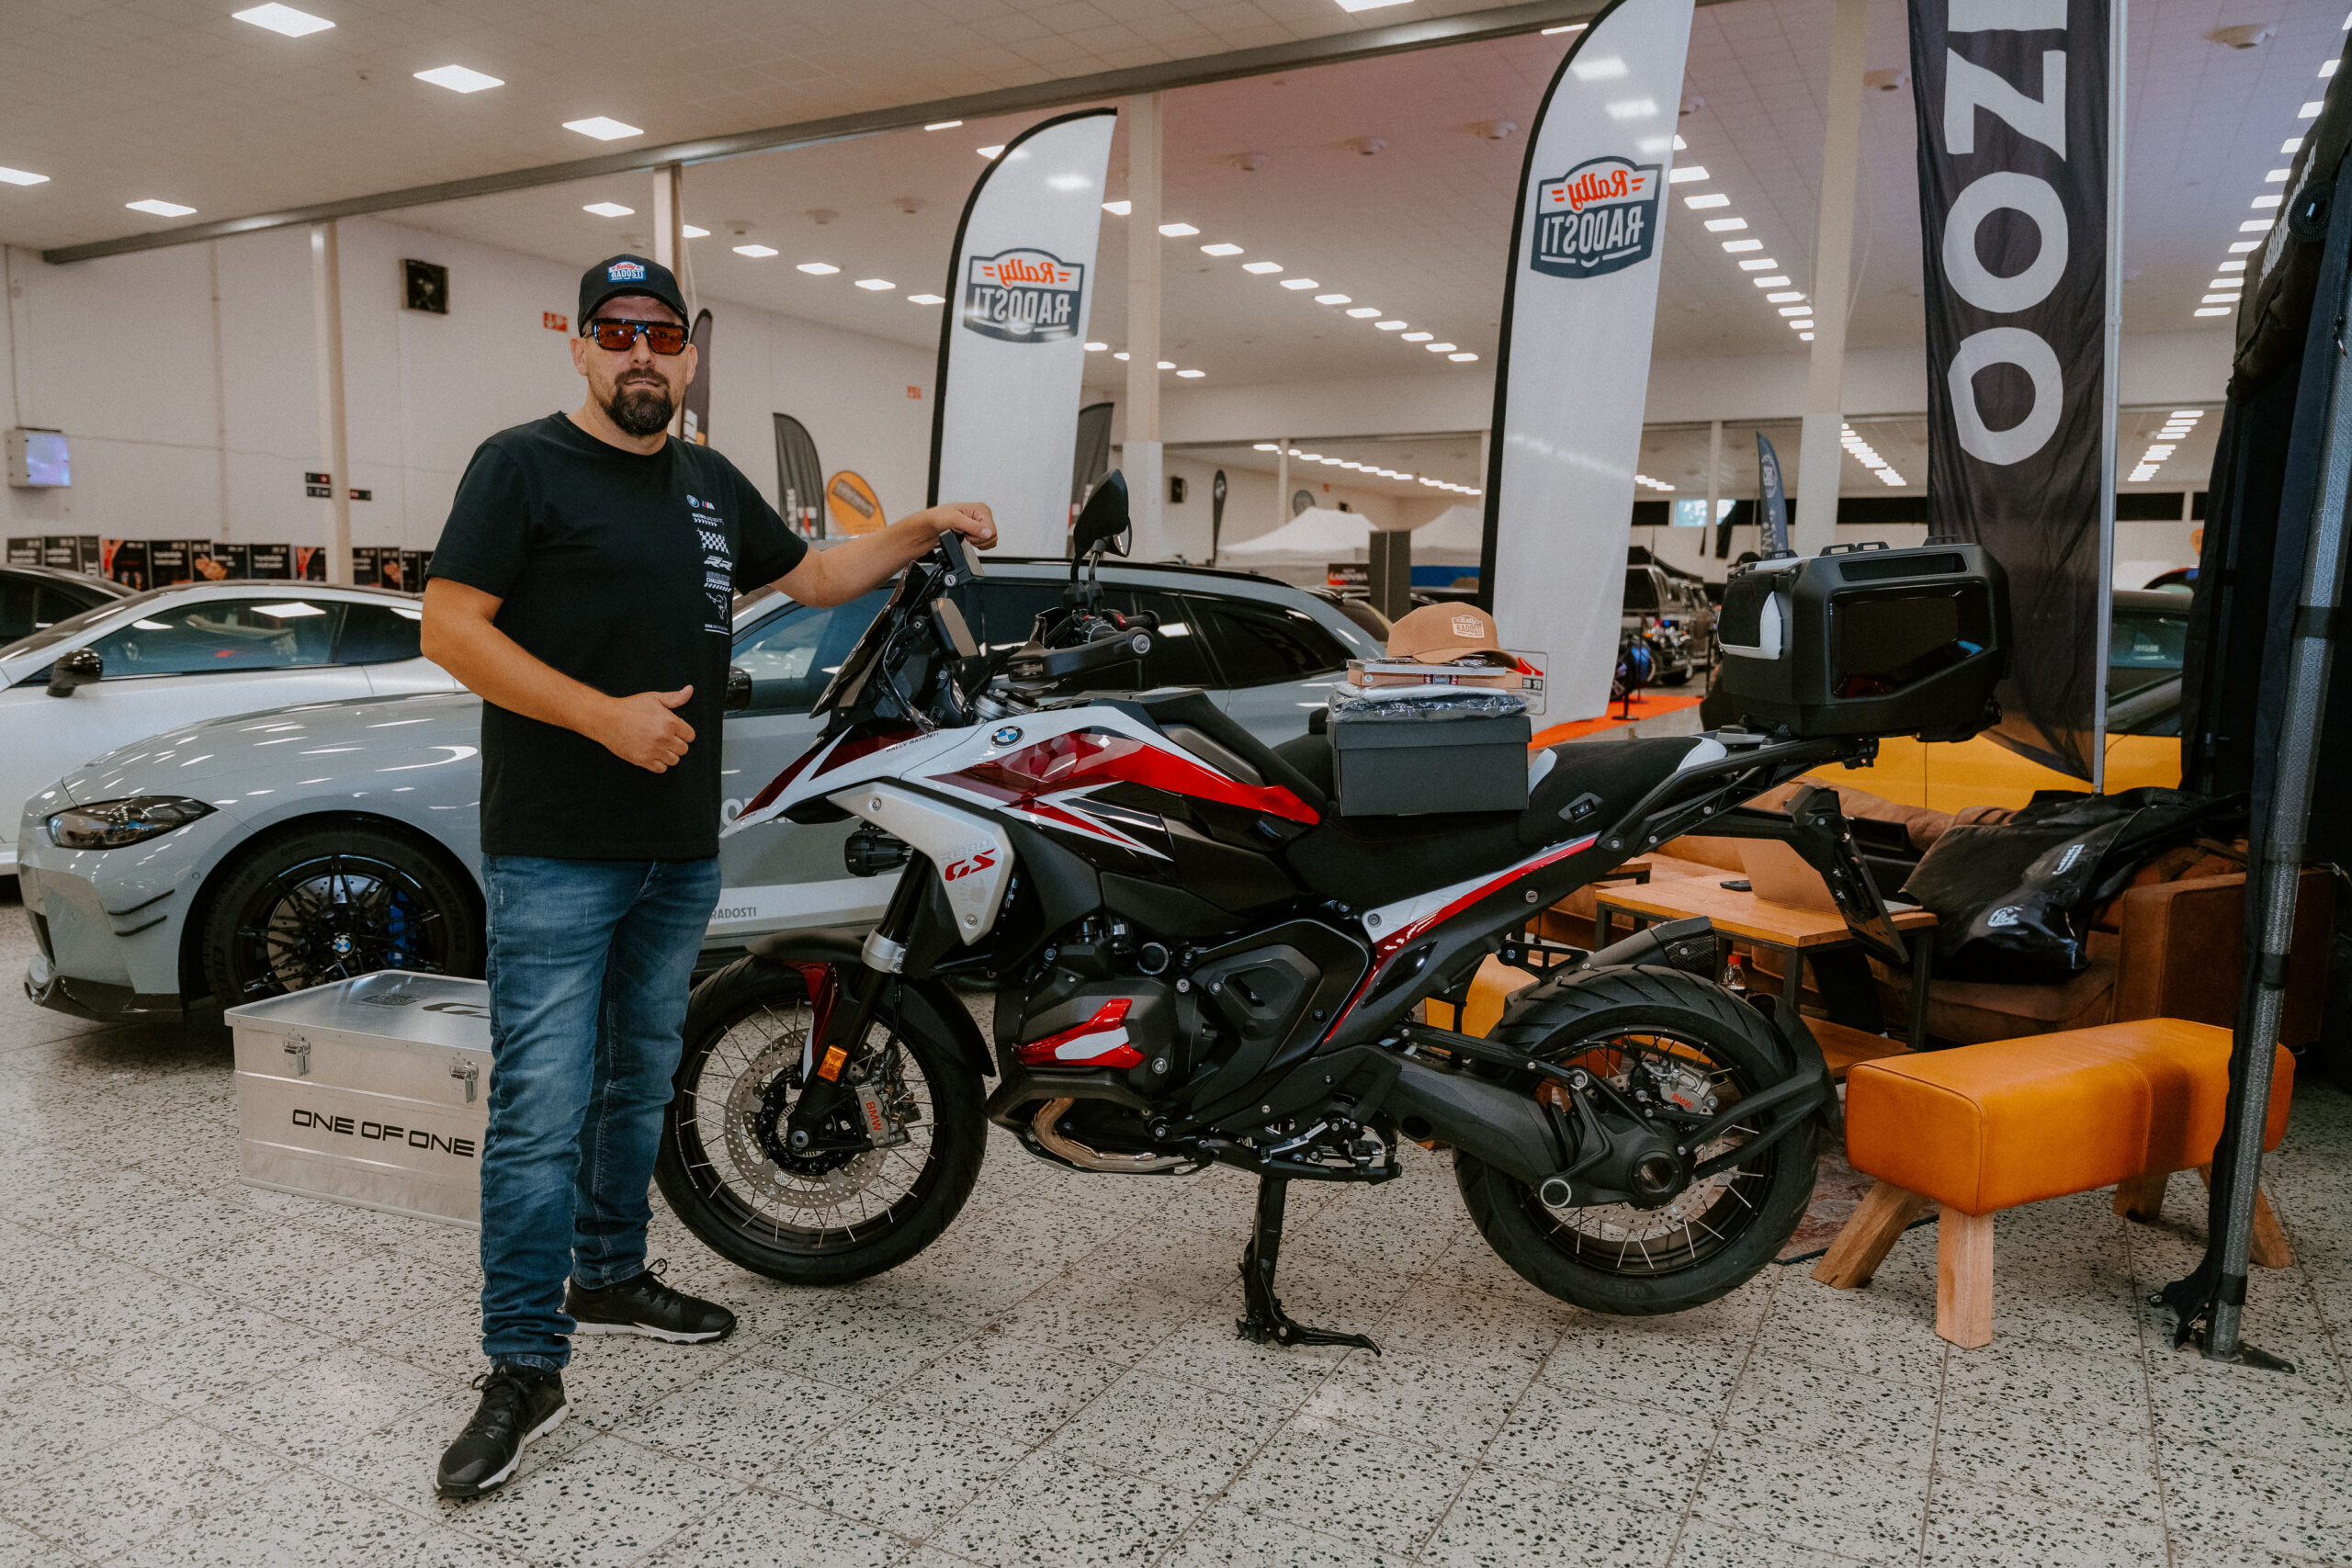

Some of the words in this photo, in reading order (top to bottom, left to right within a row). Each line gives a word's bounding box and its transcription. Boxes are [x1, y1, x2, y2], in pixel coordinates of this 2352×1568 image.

[611, 269, 644, 280] RADOSTI
[886, 741, 908, 753] RALLY
[944, 848, 995, 882] GS
[1671, 1093, 1695, 1109] BMW
[866, 1101, 883, 1131] BMW
[292, 1109, 355, 1135] ONE
[361, 1121, 405, 1142] OF
[408, 1130, 475, 1158] ONE
